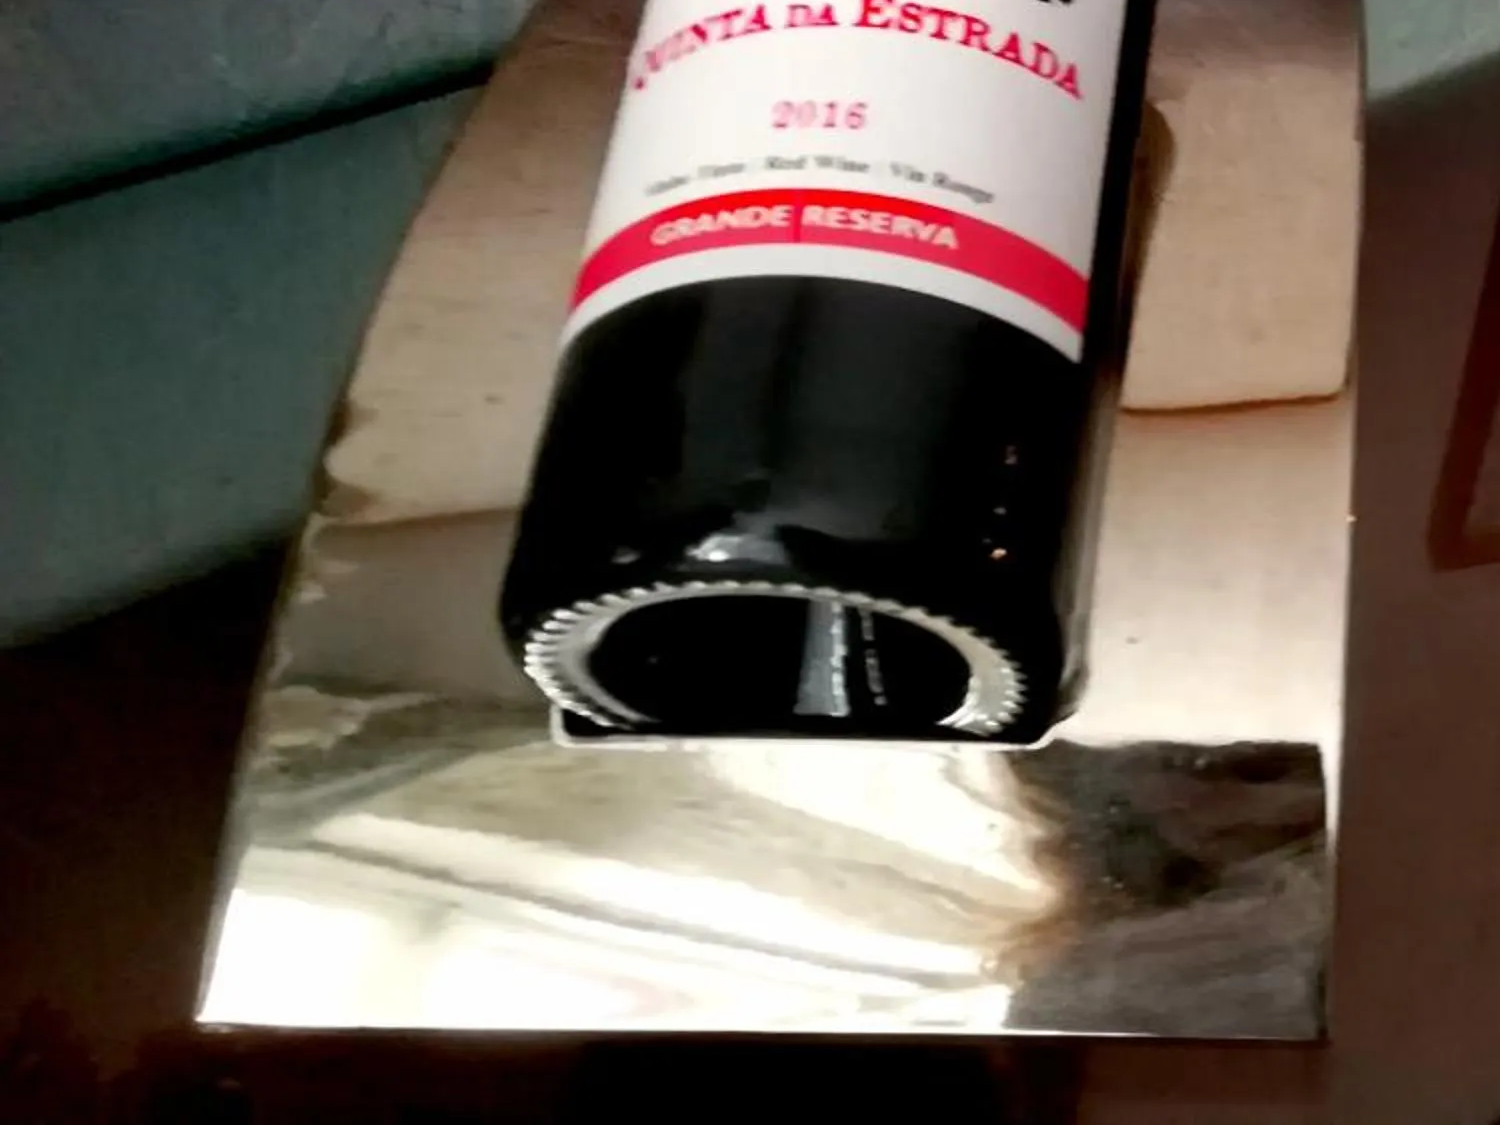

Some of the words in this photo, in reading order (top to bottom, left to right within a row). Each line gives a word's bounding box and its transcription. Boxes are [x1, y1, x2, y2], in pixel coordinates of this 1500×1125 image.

[632, 3, 772, 90] UINTA
[772, 101, 867, 129] 2016
[650, 206, 792, 246] GRANDE
[802, 205, 959, 250] RESERVA
